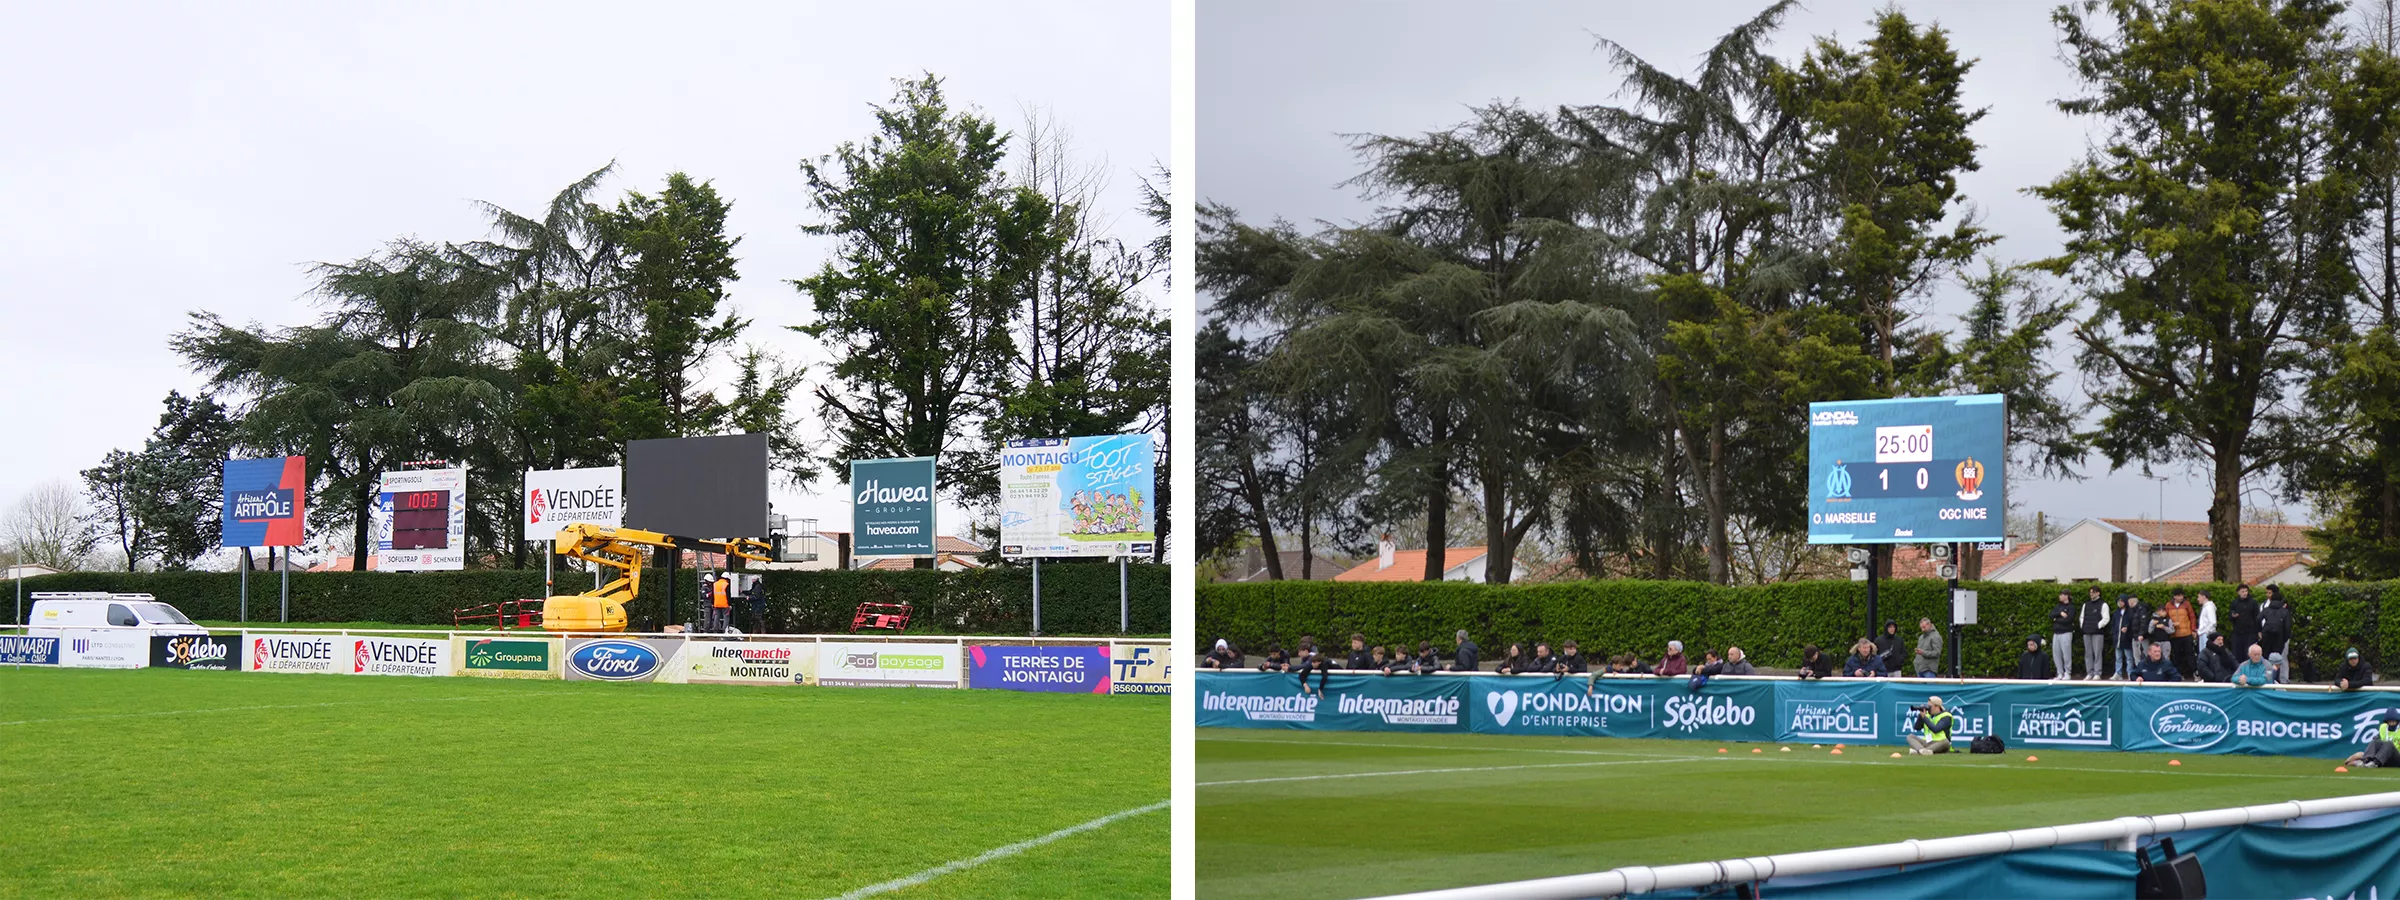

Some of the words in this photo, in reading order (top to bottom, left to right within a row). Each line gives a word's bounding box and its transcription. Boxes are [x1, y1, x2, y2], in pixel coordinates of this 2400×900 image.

[1879, 434, 1928, 454] 25:00
[1003, 452, 1080, 466] MONTAIGU
[1086, 463, 1142, 487] STAGES
[1879, 468, 1888, 490] 1
[1916, 468, 1928, 490] 0
[238, 493, 263, 502] Artisans
[546, 485, 614, 510] VENDÉE
[857, 480, 929, 504] Havea
[234, 492, 290, 517] ARTIPÔLE
[547, 513, 555, 521] LE
[558, 511, 613, 521] DÉPARTEMENT
[1825, 512, 1876, 523] MARSEILLE
[1939, 509, 1962, 520] OGC
[1963, 508, 1987, 519] NICE
[866, 525, 918, 535] havea.com
[1977, 542, 2003, 550] Bodet
[19, 638, 55, 655] MABIT
[166, 638, 227, 662] Sodebo
[269, 638, 331, 660] VENDÉE
[371, 641, 437, 664] VENDÉE
[712, 646, 791, 664] Intermarché
[269, 660, 279, 669] LE
[281, 659, 330, 670] DÉPARTEMENT
[495, 651, 542, 663] Groupama
[587, 646, 640, 673] Ford
[846, 655, 875, 666] Cap
[881, 657, 941, 668] paysage
[1002, 656, 1060, 669] TERRES
[1064, 657, 1084, 668] DE
[382, 664, 436, 674] DÉPARTEMENT
[730, 666, 789, 678] MONTAIGU
[1002, 670, 1084, 683] MONTAIGU
[1113, 684, 1142, 693] 85600
[1203, 691, 1318, 720] Intermarché
[1338, 694, 1459, 723] Intermarché
[1522, 693, 1642, 714] FONDATION
[1663, 696, 1755, 727] Sodebo
[1796, 704, 1832, 715] Artisans
[2168, 704, 2212, 714] BRIOCHES
[1522, 715, 1607, 728] D'ENTREPRISE
[1791, 704, 1869, 732] ARTIPÔLE
[2017, 708, 2102, 737] ARTIPÔLE
[2022, 708, 2061, 720] Artisans
[2158, 714, 2224, 734] Fonteneau
[2237, 720, 2342, 740] BRIOCHES
